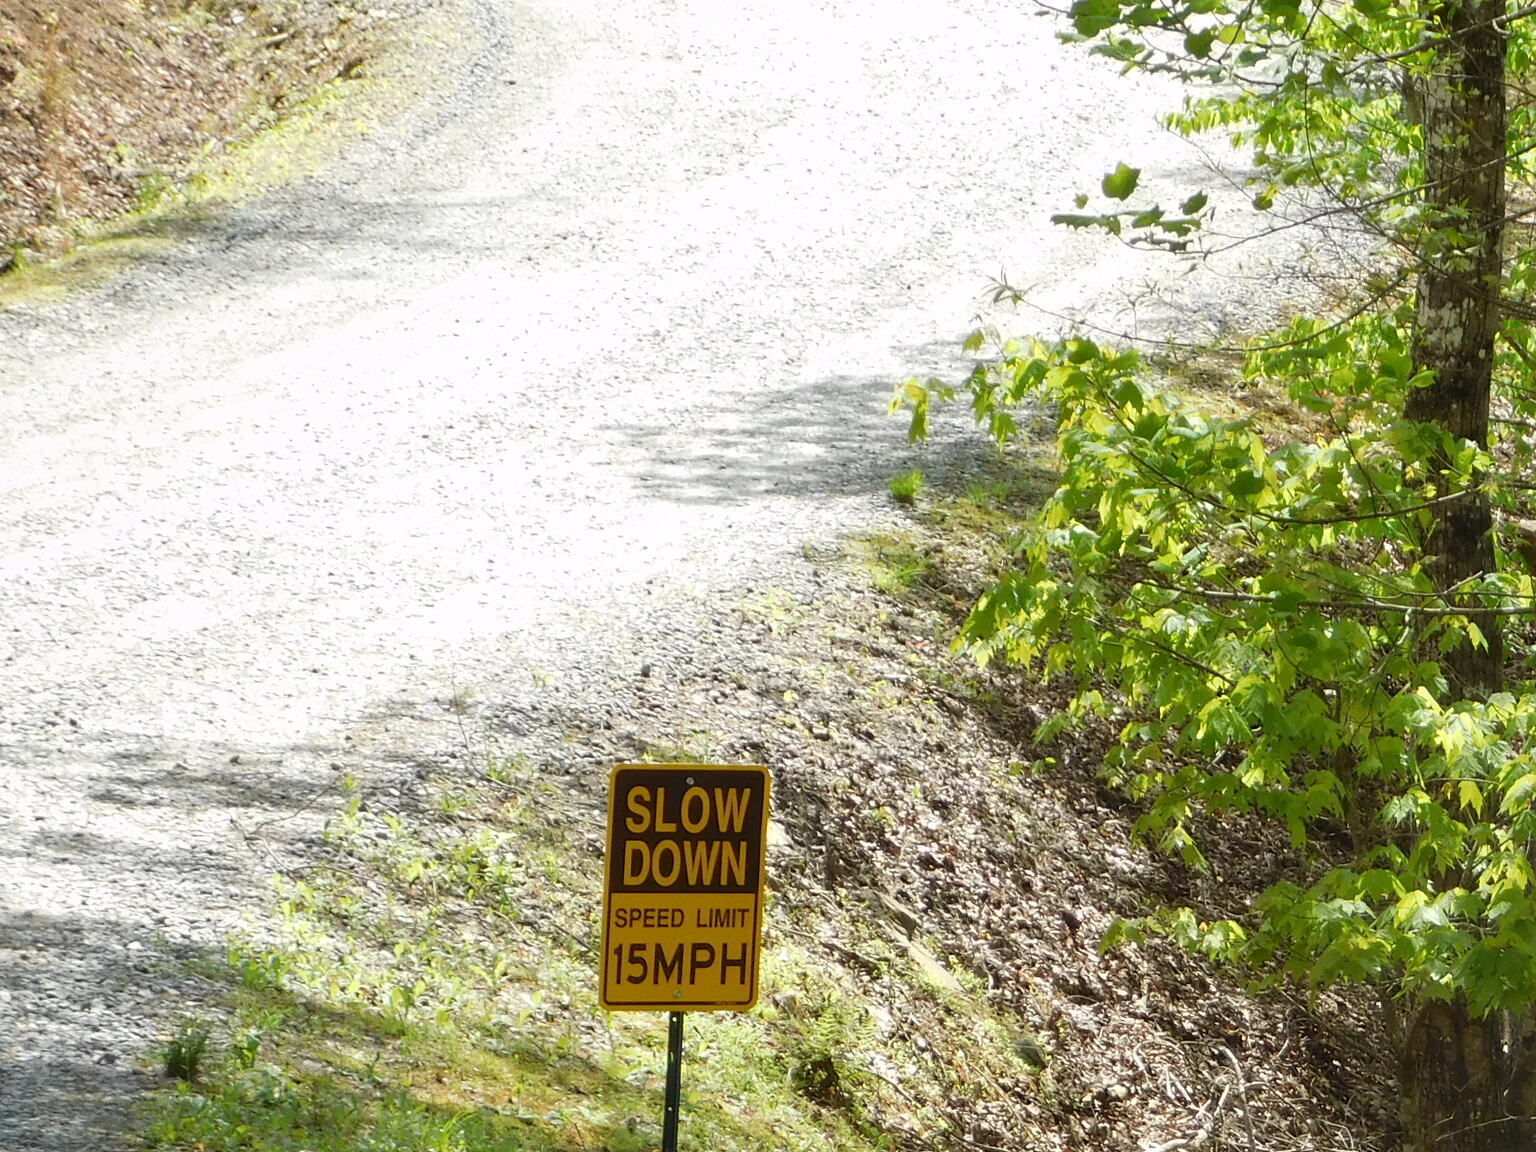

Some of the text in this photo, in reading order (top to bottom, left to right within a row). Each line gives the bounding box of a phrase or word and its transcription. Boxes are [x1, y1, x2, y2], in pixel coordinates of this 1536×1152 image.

[625, 786, 751, 834] SLOW
[623, 839, 747, 887] DOWN
[614, 908, 750, 928] SPEED LIMIT
[613, 942, 748, 985] 15MPH
